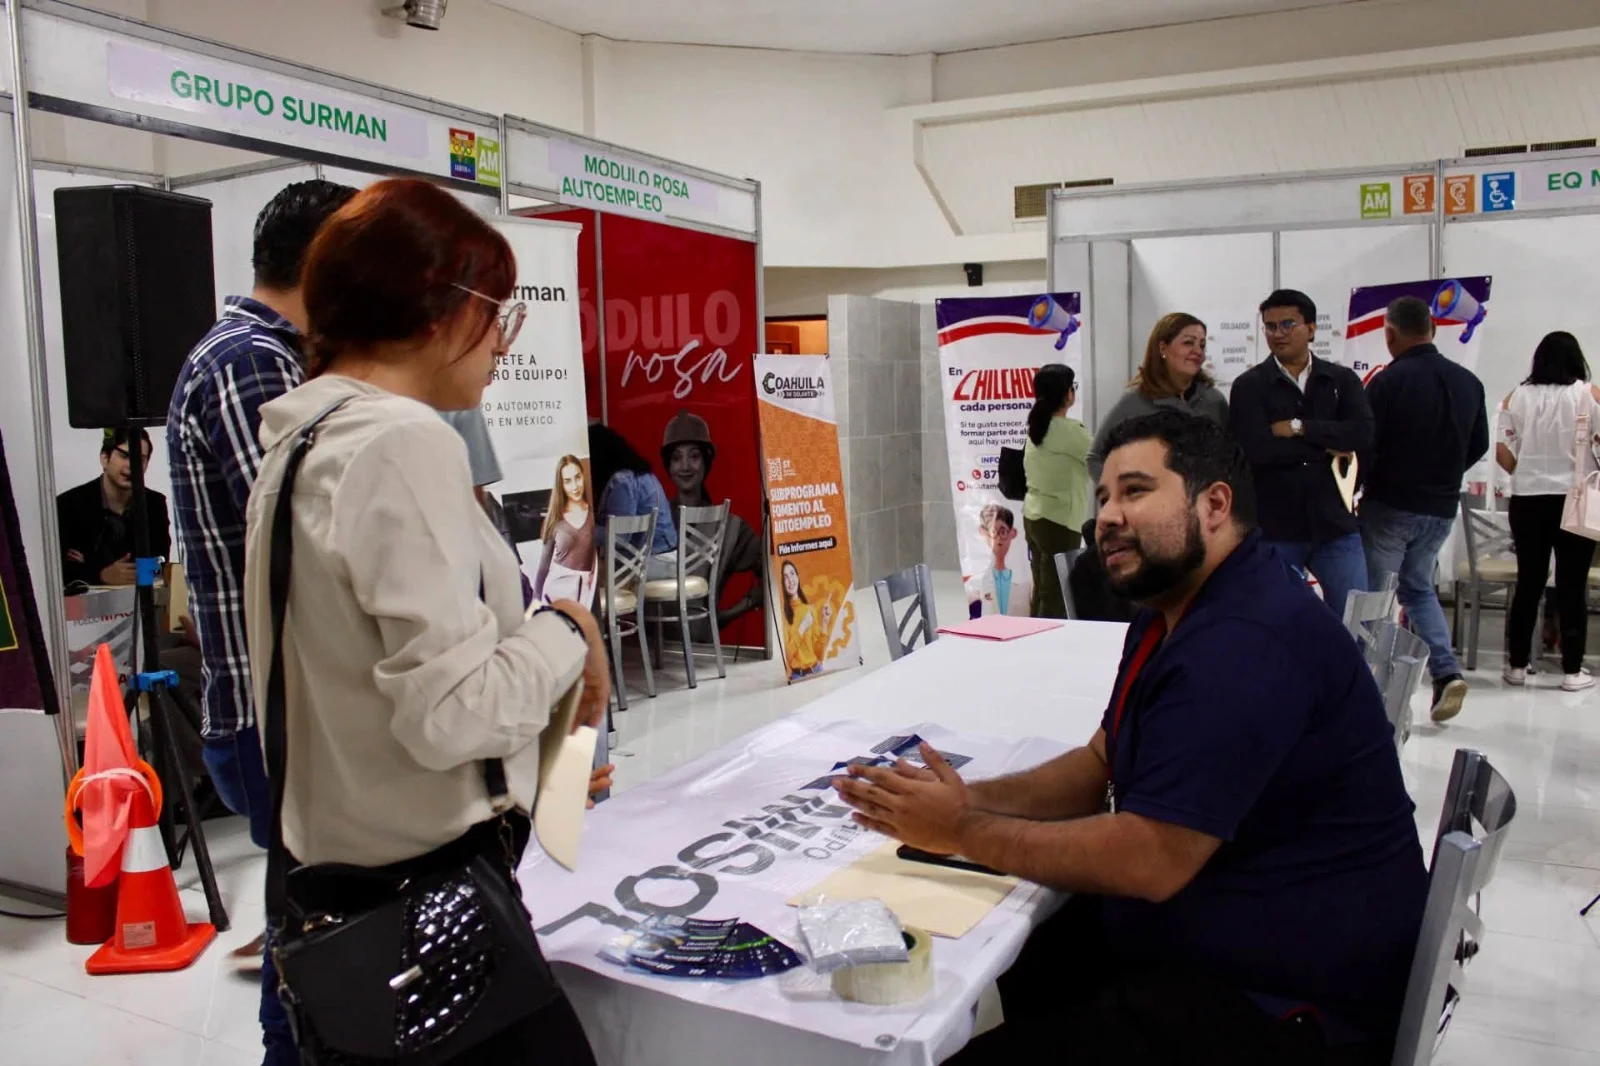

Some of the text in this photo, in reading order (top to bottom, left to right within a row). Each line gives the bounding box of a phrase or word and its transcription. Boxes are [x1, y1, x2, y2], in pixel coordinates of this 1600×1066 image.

[170, 70, 387, 142] GRUPO SURMAN
[479, 148, 498, 173] AM
[653, 172, 690, 199] ROSA
[1547, 171, 1583, 191] EQ
[562, 176, 663, 213] AUTOEMPLEO
[1363, 192, 1388, 210] AM
[512, 285, 566, 302] rman
[579, 288, 741, 353] ÓDULO
[494, 354, 537, 366] NETE A
[1353, 361, 1369, 371] En
[515, 369, 568, 381] EQUIPO!
[621, 339, 743, 399] rosa
[949, 367, 963, 376] En
[762, 372, 825, 394] COAHUILA
[497, 400, 562, 412] AUTOMOTRIZ
[960, 402, 1033, 413] cada persona
[499, 417, 512, 427] EN
[977, 421, 998, 429] gusta
[999, 420, 1025, 428] crecer,
[986, 437, 999, 446] hay
[987, 430, 1007, 438] parte
[981, 456, 1000, 464] INFO
[770, 482, 839, 502] SUBPROGRAMA
[772, 500, 826, 518] FOMENTO AL
[774, 514, 832, 534] AUTOEMPLEO
